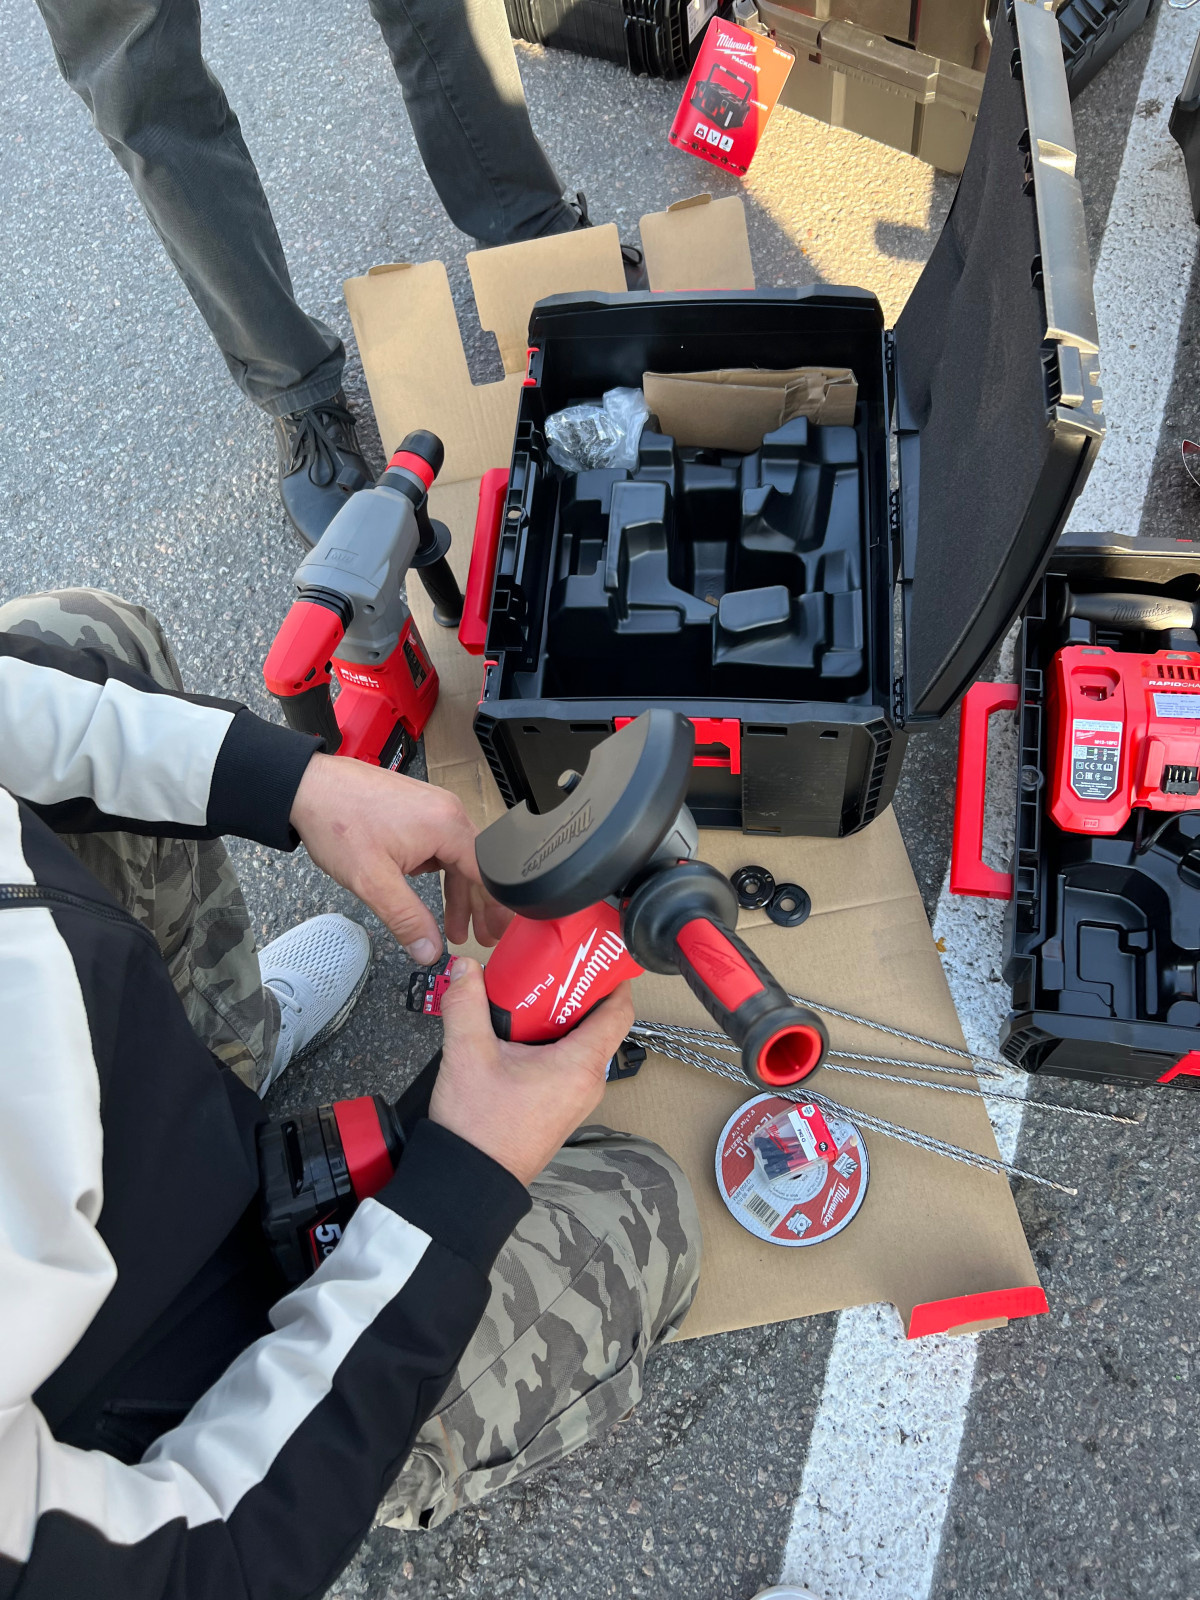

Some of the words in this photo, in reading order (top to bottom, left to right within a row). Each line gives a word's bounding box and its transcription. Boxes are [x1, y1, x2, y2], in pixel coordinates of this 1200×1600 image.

[716, 33, 758, 53] Milwaukee
[731, 55, 761, 73] PACKOUT
[1111, 602, 1172, 622] Milwaukee
[340, 667, 378, 684] FUEL
[521, 804, 596, 877] Milwaukee
[515, 973, 555, 1010] FUEL
[554, 929, 628, 1026] Milwaukee
[821, 1182, 850, 1228] Milwaukee
